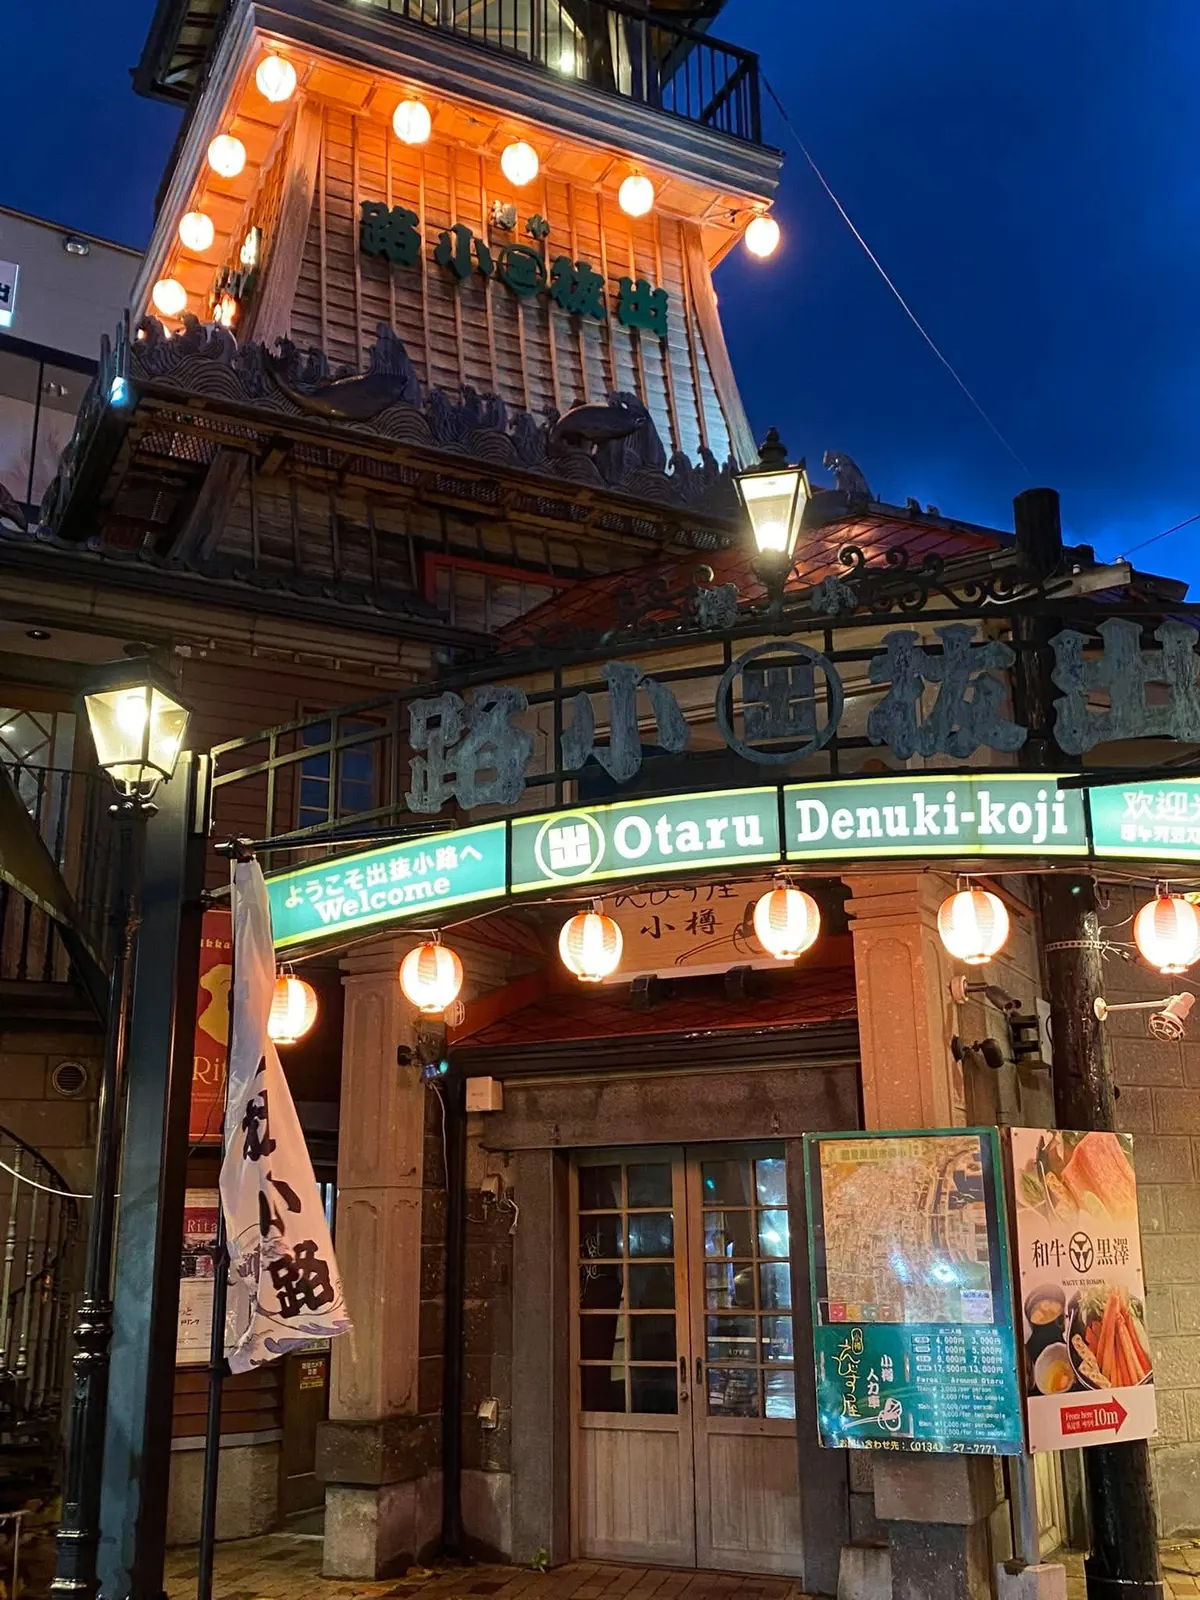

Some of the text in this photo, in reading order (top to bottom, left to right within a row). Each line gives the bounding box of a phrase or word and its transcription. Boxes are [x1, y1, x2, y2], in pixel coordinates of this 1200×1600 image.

[613, 789, 1069, 859] Otaru Denuki-koji
[285, 845, 483, 908] ようこそ出抜小路へ
[313, 876, 451, 924] Welcome
[640, 908, 723, 939] 小樽
[187, 1218, 218, 1233] Rita
[1031, 1238, 1066, 1268] 和牛
[1093, 1408, 1119, 1427] 10m
